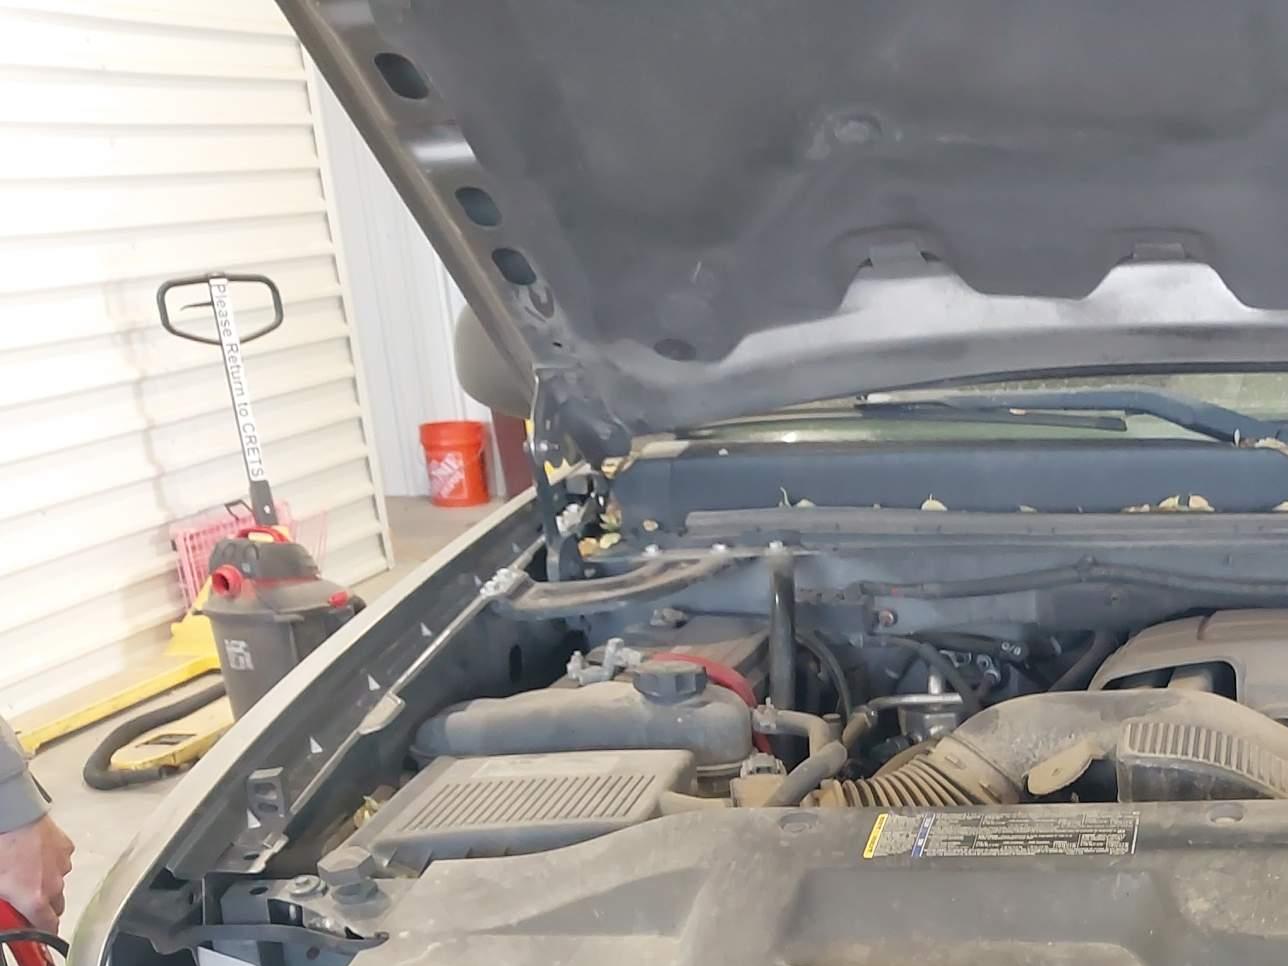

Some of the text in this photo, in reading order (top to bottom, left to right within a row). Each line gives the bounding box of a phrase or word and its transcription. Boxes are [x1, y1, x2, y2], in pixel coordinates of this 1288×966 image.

[212, 283, 264, 477] Please Return to CRETS
